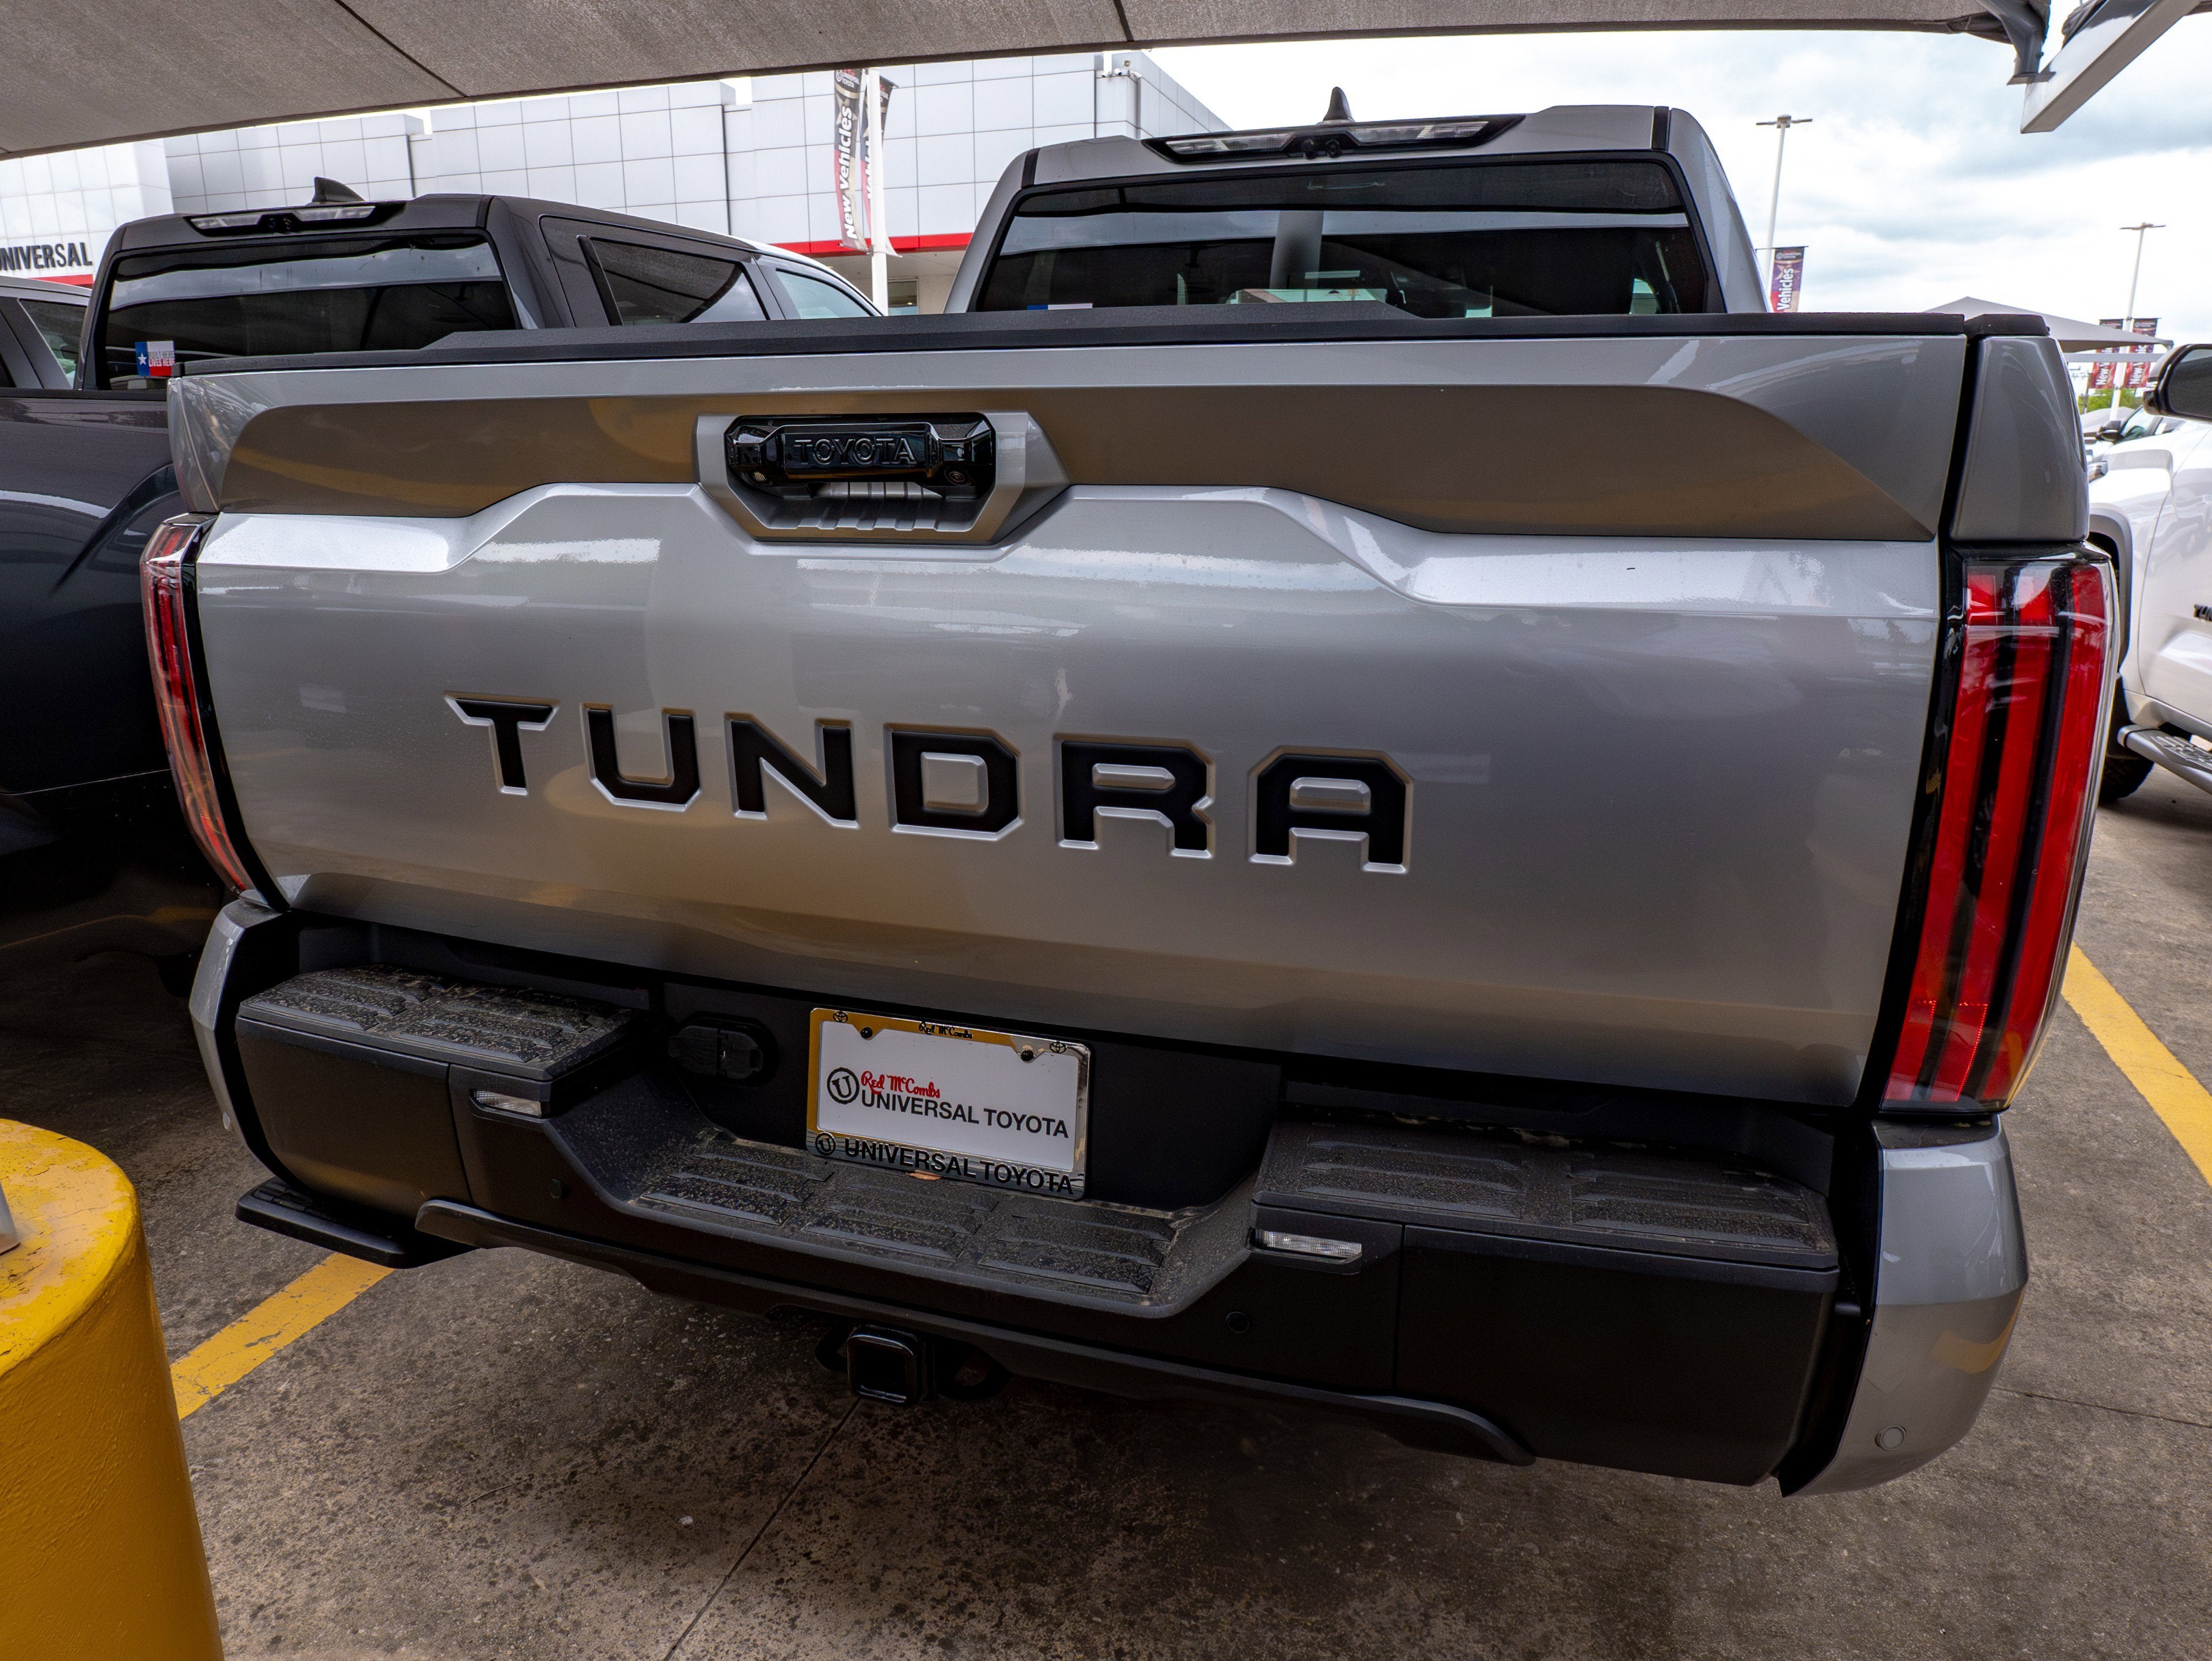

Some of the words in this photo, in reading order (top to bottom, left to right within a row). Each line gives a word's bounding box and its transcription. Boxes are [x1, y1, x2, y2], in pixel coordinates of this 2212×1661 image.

[839, 105, 852, 190] Vehicles
[844, 195, 858, 239] New
[0, 242, 93, 271] NIVERSAL
[1777, 268, 1794, 311] Vehicles
[2095, 368, 2109, 385] New
[2128, 367, 2143, 385] New
[794, 438, 917, 465] TOYOTA
[444, 693, 1413, 874] TUNDRA
[861, 1070, 885, 1095] Red
[861, 1089, 979, 1125] UNIVERSAL
[983, 1108, 1069, 1138] TOYOTA
[844, 1137, 976, 1178] UNIVERSAL
[980, 1159, 1073, 1195] TOYOTA
